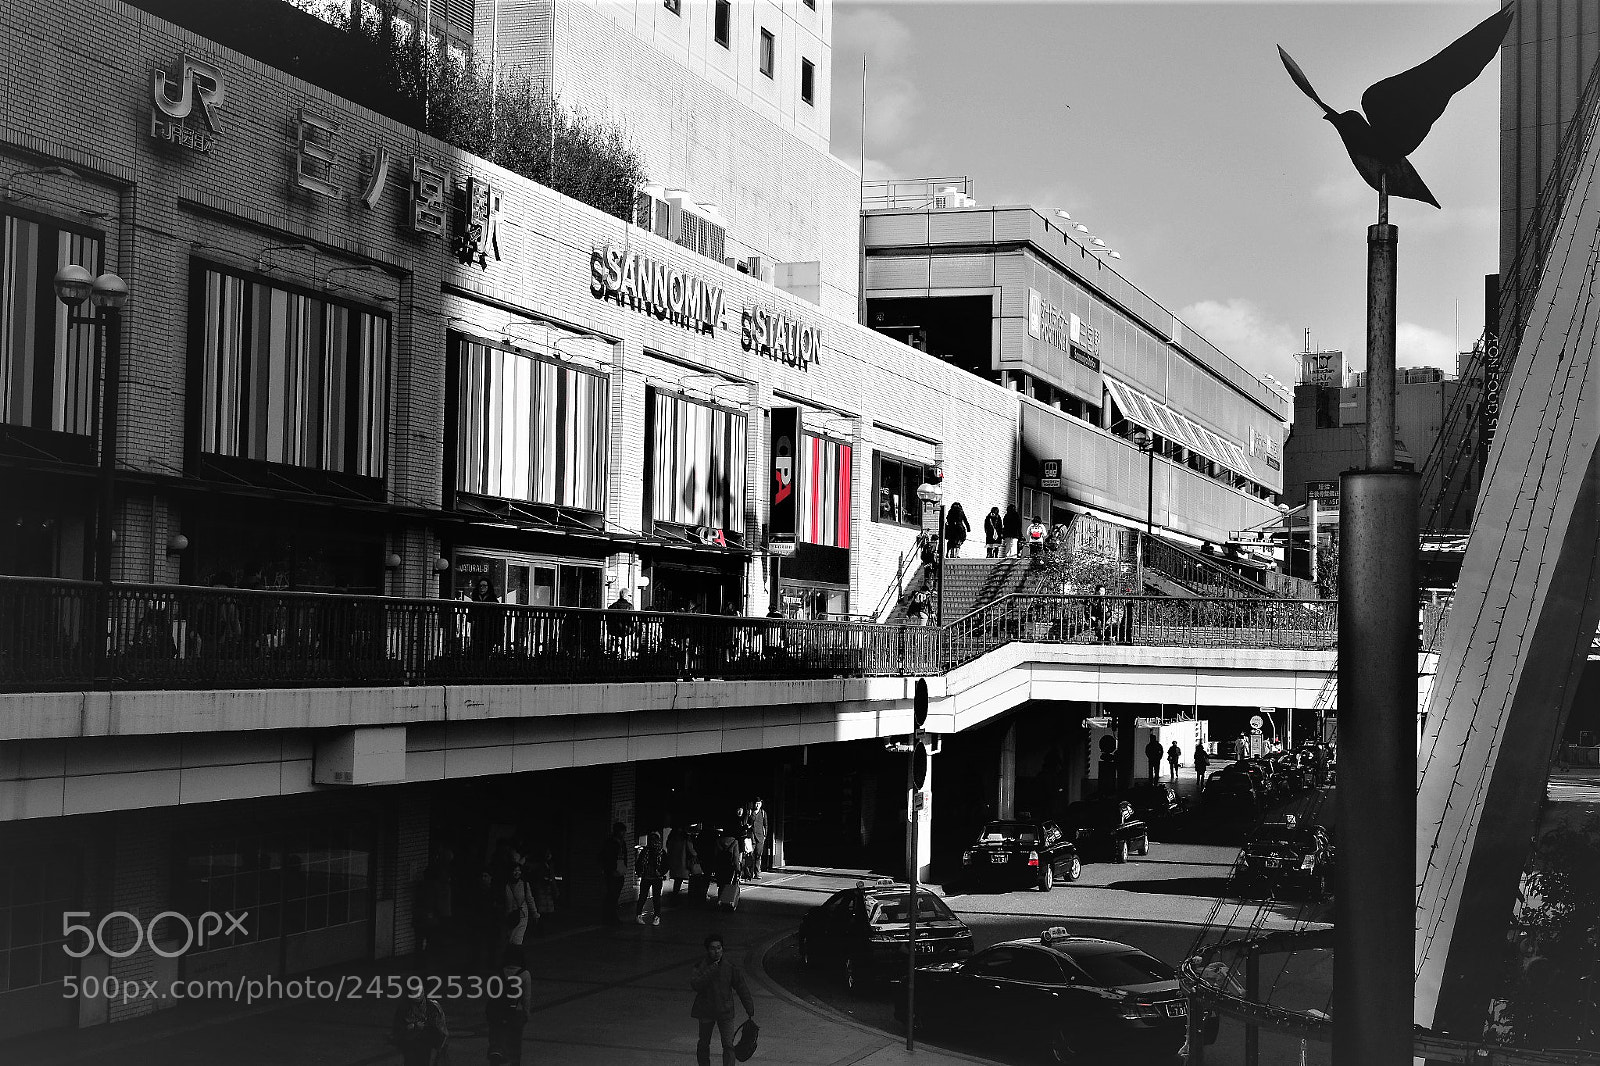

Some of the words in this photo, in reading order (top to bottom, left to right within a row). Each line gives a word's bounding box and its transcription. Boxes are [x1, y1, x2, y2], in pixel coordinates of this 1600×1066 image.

[154, 53, 225, 134] JR
[602, 243, 728, 331] SANNOMIYA
[750, 302, 823, 365] STATION
